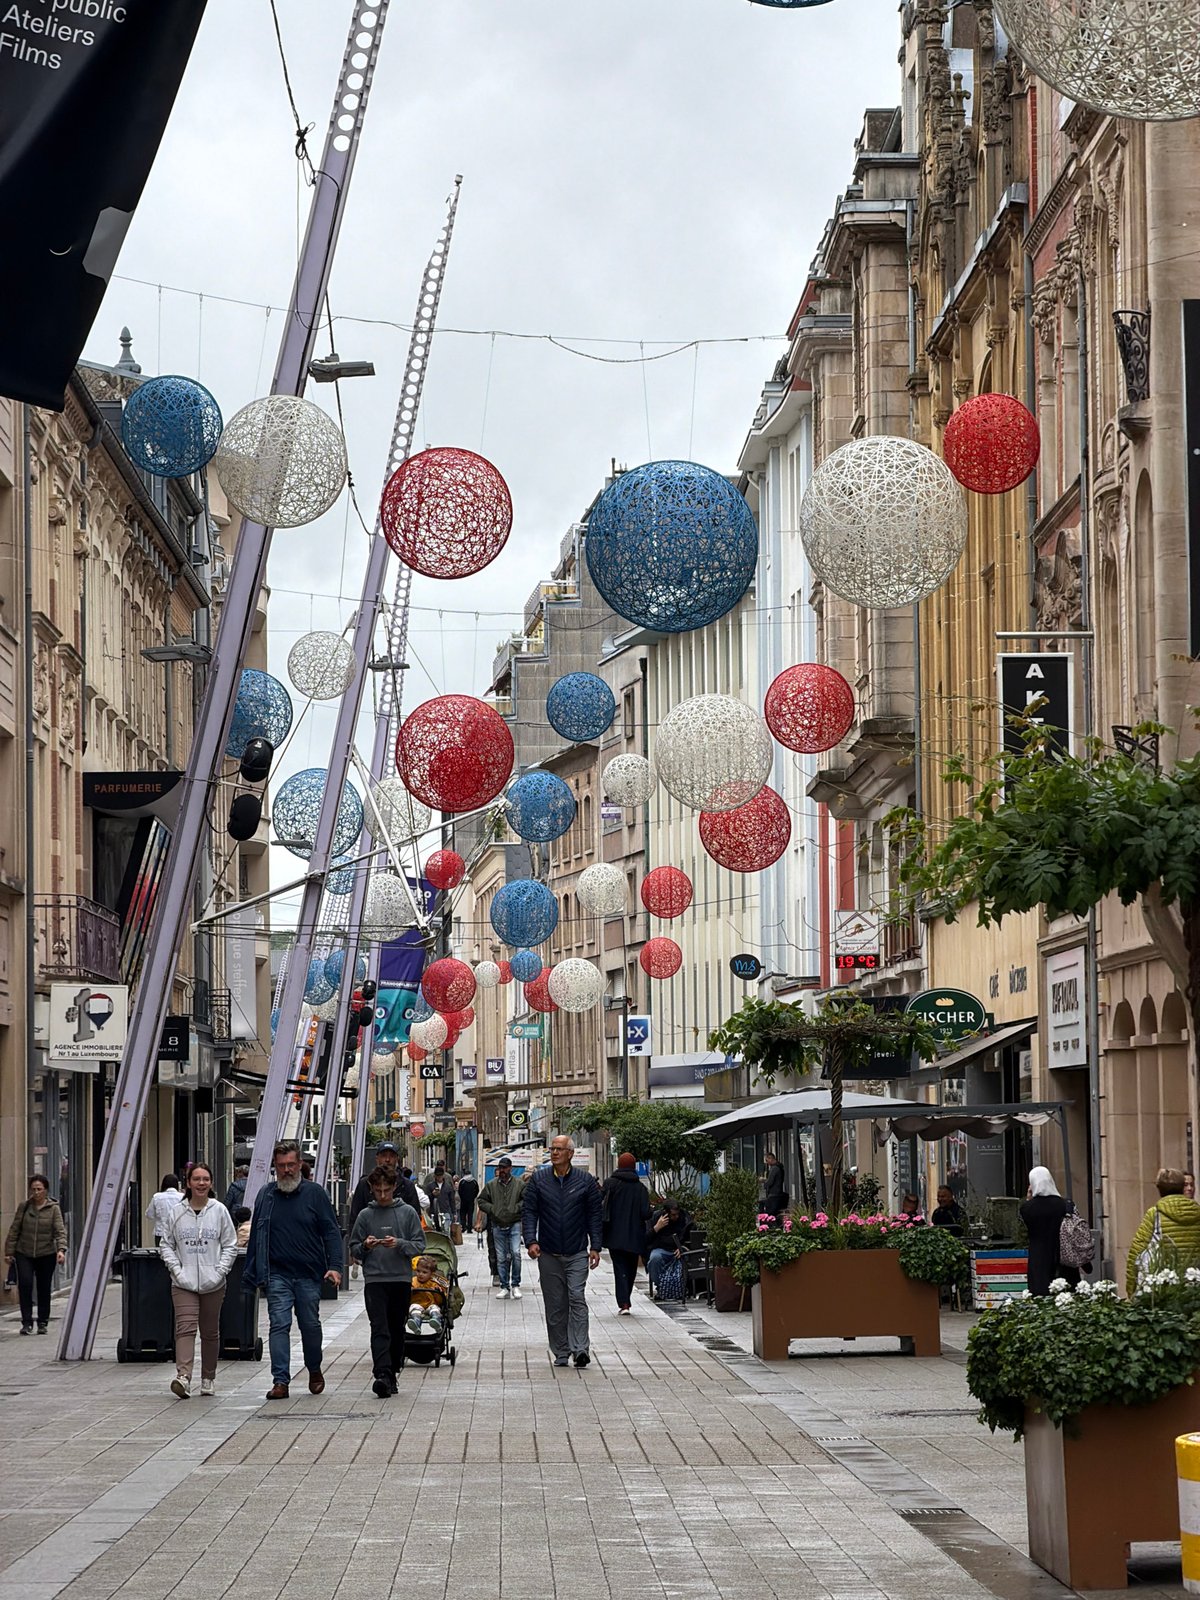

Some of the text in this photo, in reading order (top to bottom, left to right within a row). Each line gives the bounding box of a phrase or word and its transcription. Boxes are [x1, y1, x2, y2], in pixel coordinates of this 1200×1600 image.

[52, 0, 127, 23] public
[1, 4, 95, 46] Ateliers
[0, 32, 62, 69] Films
[94, 783, 162, 793] PARFUMERIE
[838, 955, 855, 968] 19
[232, 962, 248, 1002] steffen
[80, 1050, 119, 1058] Luxembourg
[508, 1049, 516, 1080] veritas
[422, 1067, 440, 1077] C&A
